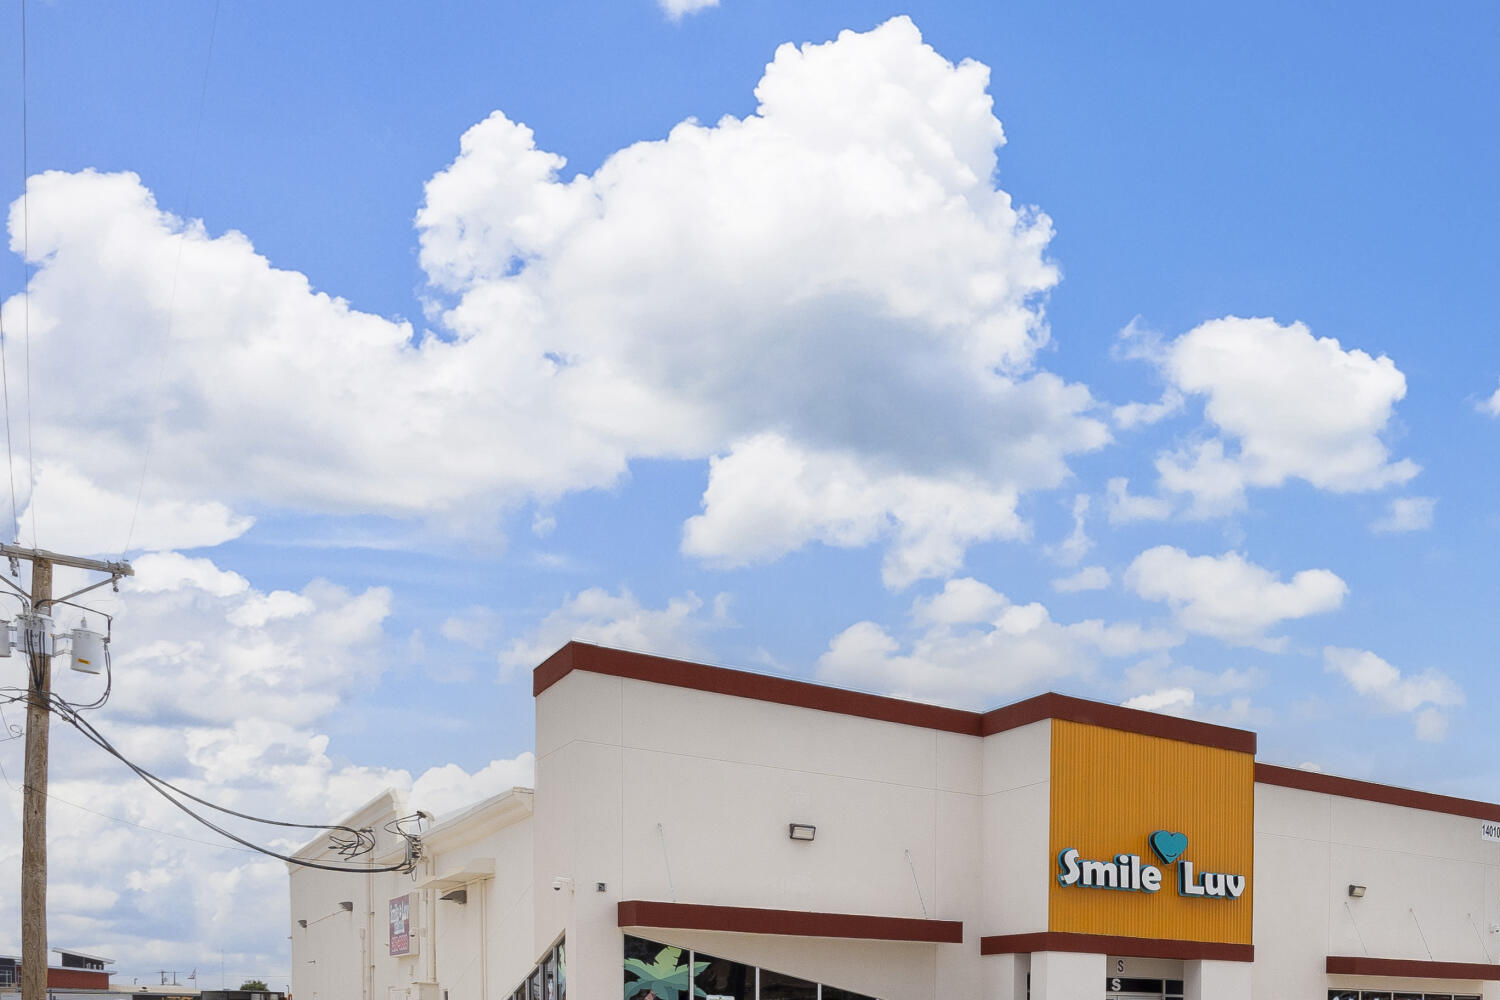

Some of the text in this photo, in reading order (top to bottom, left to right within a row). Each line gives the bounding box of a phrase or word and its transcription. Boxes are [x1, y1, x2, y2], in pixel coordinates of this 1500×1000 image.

[1482, 824, 1500, 838] 14010
[1058, 848, 1246, 899] Smile Luv
